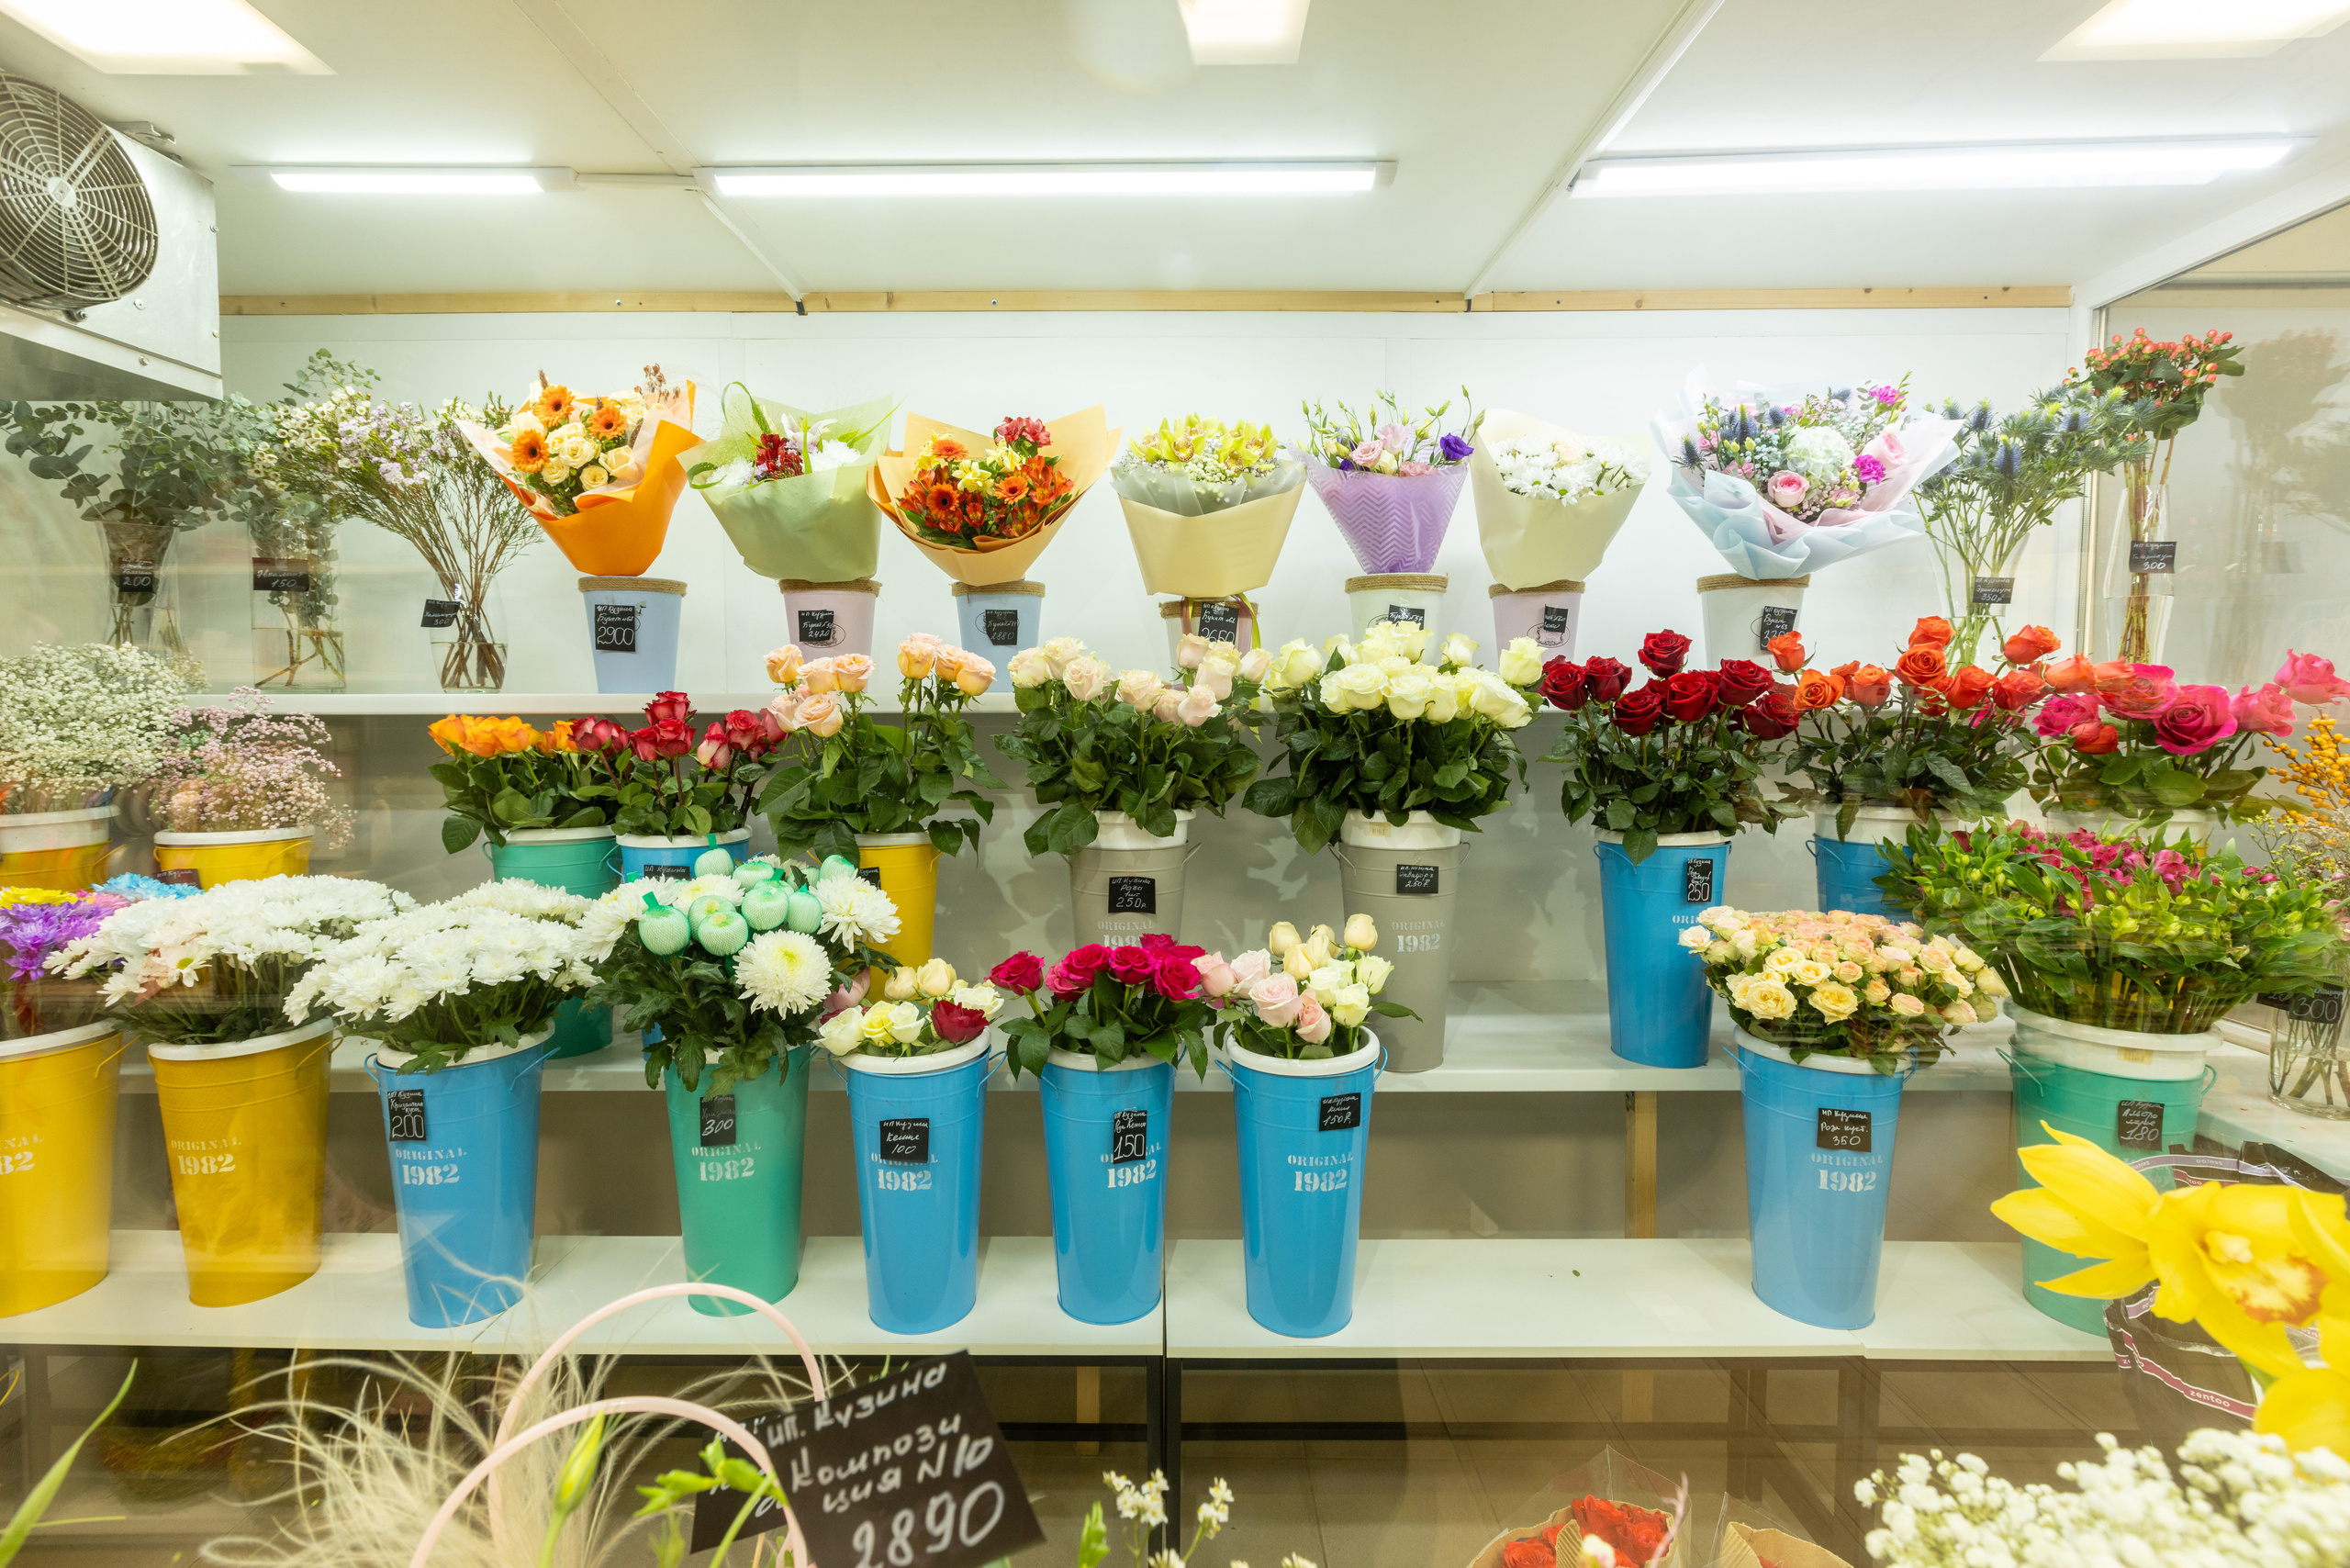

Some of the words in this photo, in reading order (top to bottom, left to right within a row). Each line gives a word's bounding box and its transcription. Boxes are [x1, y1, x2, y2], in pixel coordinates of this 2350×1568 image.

[2143, 562, 2166, 570] 300
[123, 577, 151, 586] 200
[272, 578, 297, 588] 150
[608, 606, 632, 615] Кузина
[1203, 610, 1225, 622] Букет
[597, 613, 621, 624] Букет
[597, 626, 633, 645] 2900
[990, 632, 1014, 641] 2880
[1687, 883, 1709, 902] 250
[1098, 921, 1155, 931] ORIGINAL
[1392, 919, 1445, 931] ORIGINAL
[1103, 935, 1141, 950] 198
[1397, 933, 1441, 953] 1982
[2293, 997, 2338, 1021] 300
[397, 1092, 422, 1100] Кузина
[1834, 1111, 1868, 1122] Кузина
[392, 1114, 424, 1138] 200
[701, 1119, 734, 1137] 300
[1832, 1136, 1861, 1146] 350
[2121, 1126, 2159, 1142] 180
[171, 1137, 241, 1151] ORIGINAL
[692, 1142, 762, 1157] ORIGINAL
[892, 1144, 916, 1155] 100
[1114, 1134, 1145, 1160] 150
[396, 1148, 466, 1161] ORIGINAL
[1287, 1152, 1353, 1167] ORIGINAL
[1810, 1153, 1884, 1168] ORIGINAL
[178, 1153, 236, 1175] 1982
[699, 1157, 755, 1182] 1982
[402, 1164, 460, 1186] 1982
[878, 1170, 933, 1192] 1982
[1107, 1159, 1157, 1188] 1982
[1294, 1169, 1348, 1193] 1982
[1818, 1170, 1877, 1193] 1982
[815, 1362, 947, 1432] Кузина
[2190, 1390, 2231, 1407] zentoo
[791, 1414, 961, 1495] Компози
[852, 1480, 1005, 1568] 2890
